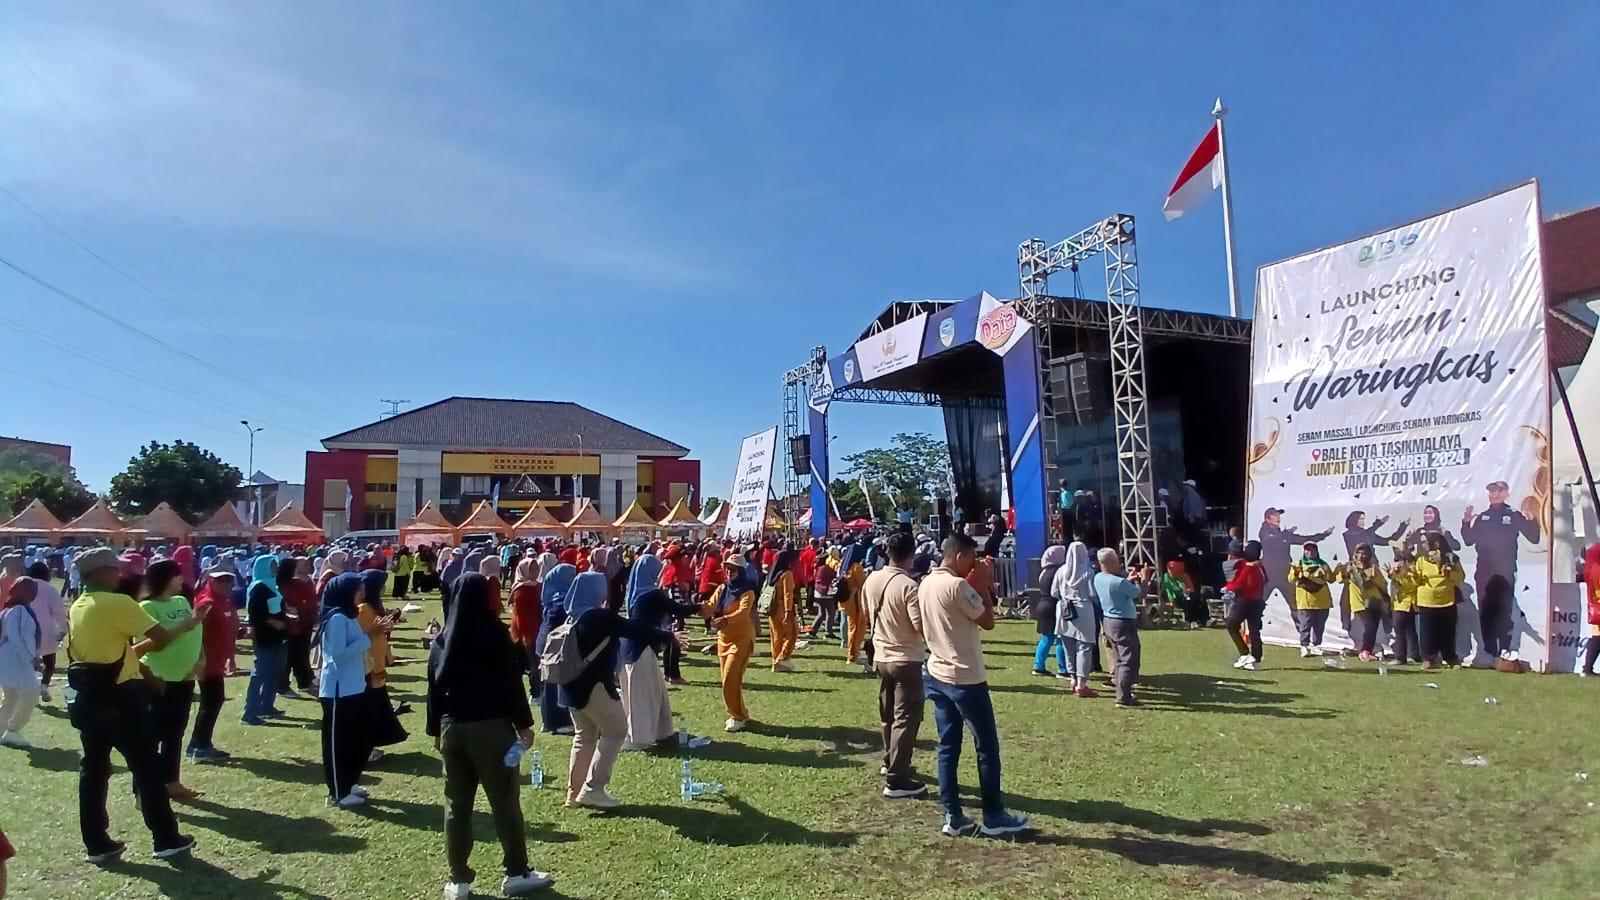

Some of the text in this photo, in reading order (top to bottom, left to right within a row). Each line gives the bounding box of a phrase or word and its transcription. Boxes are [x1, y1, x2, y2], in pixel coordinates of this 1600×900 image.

[1320, 266, 1456, 314] LAUNCHING
[980, 308, 1016, 345] Daia
[1284, 346, 1498, 412] Waringkas
[1297, 410, 1482, 442] SENAM MASSAL LAUNCHING SENAM WARINGKAS
[1306, 448, 1466, 477] JUM'AT 13 DESEMBER 2024
[1321, 433, 1462, 462] BALE KOTA TASIKMALAYA
[1340, 468, 1438, 490] JAM 07.00 WIB
